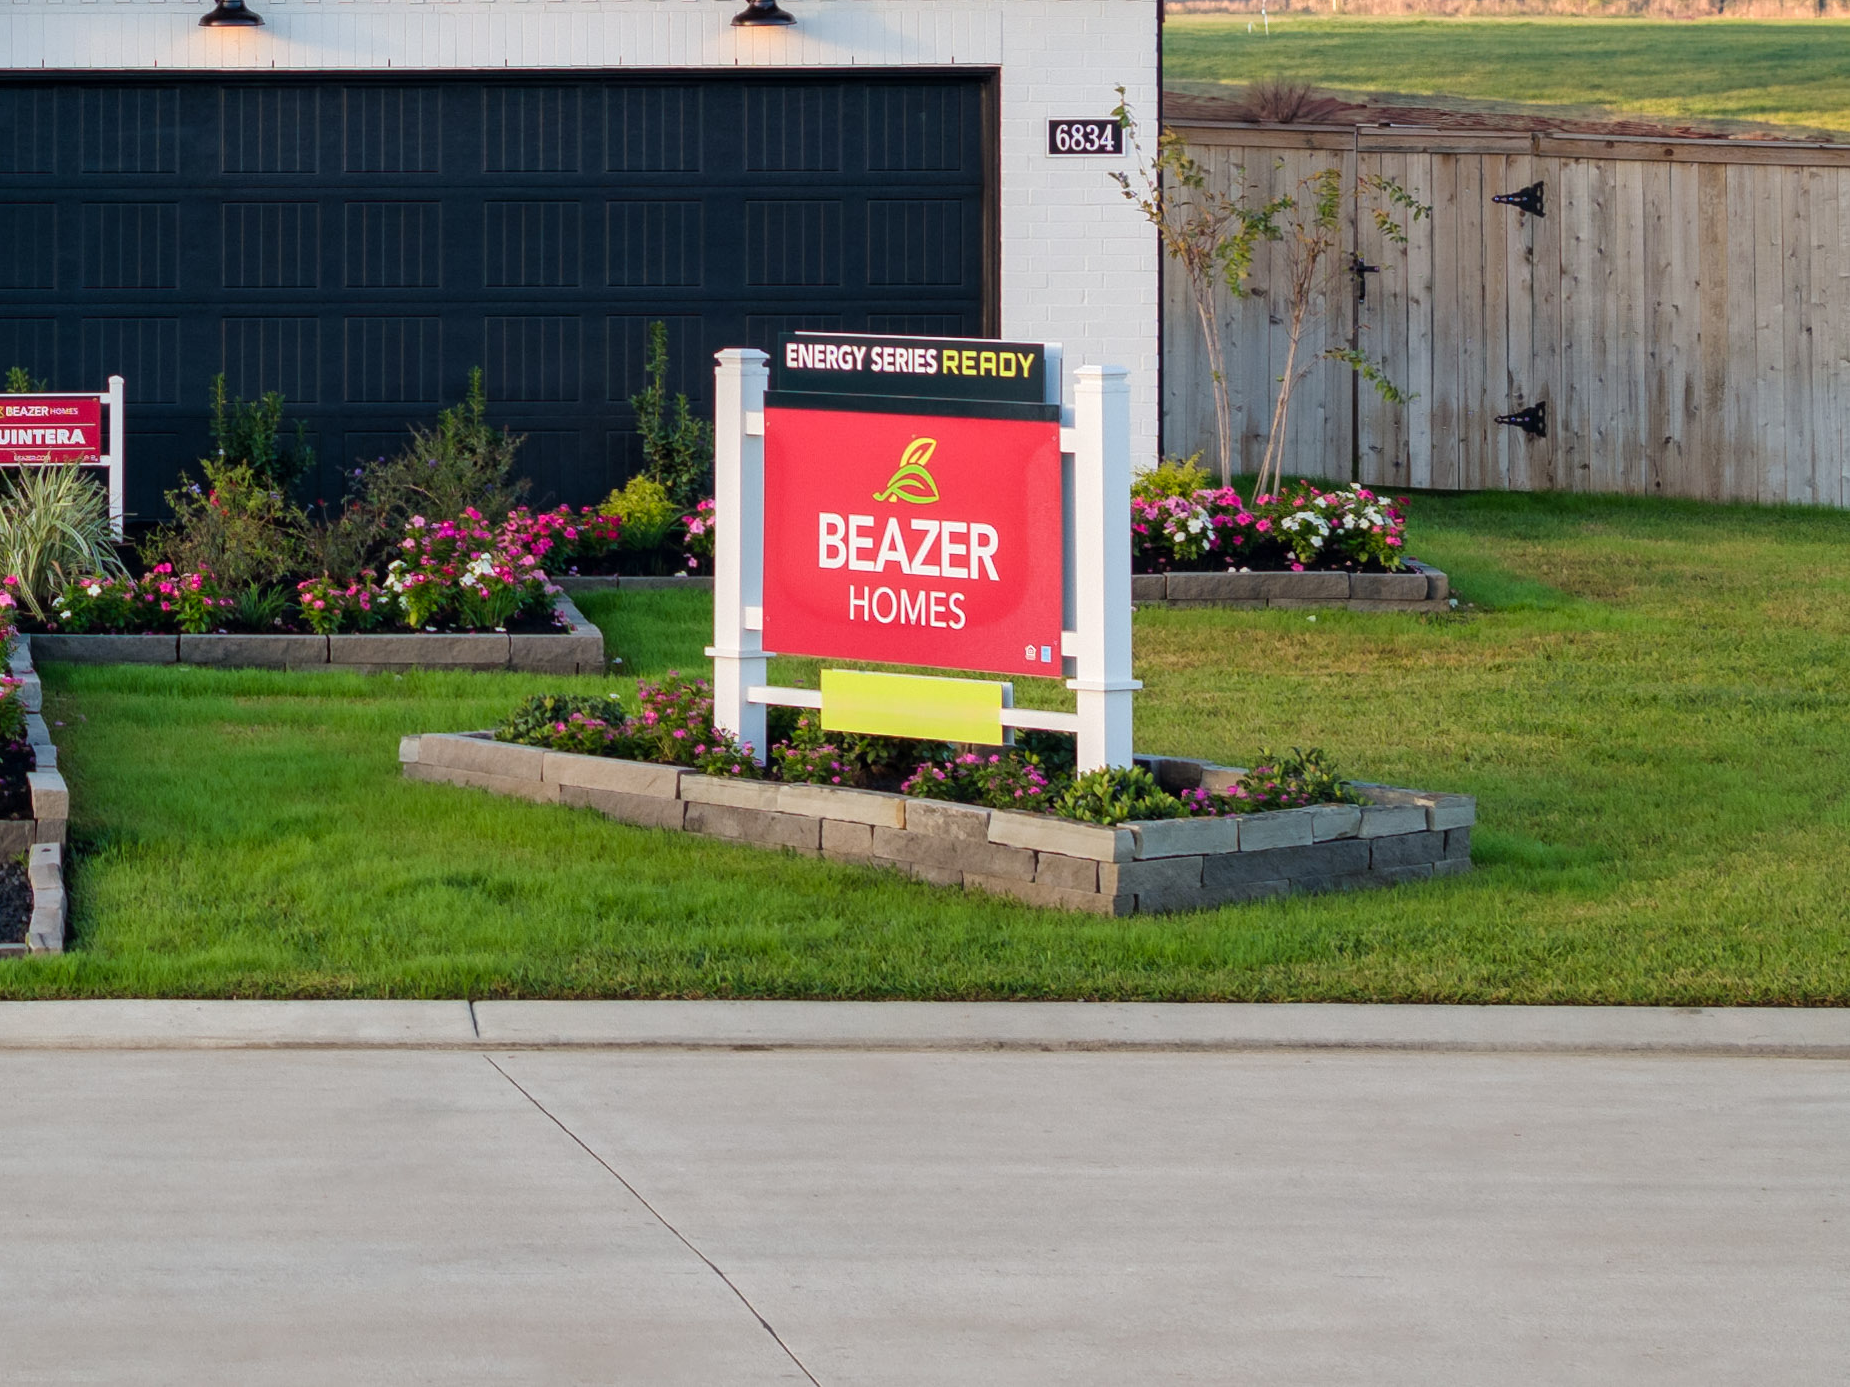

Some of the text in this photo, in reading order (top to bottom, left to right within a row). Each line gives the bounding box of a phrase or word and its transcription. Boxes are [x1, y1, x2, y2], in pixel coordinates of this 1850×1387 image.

[1056, 124, 1114, 151] 6834
[786, 343, 1035, 378] ENERGY SERIES READY
[5, 406, 78, 417] BEAZER HOMES
[818, 512, 1001, 581] BEAZER
[849, 585, 966, 630] HOMES
